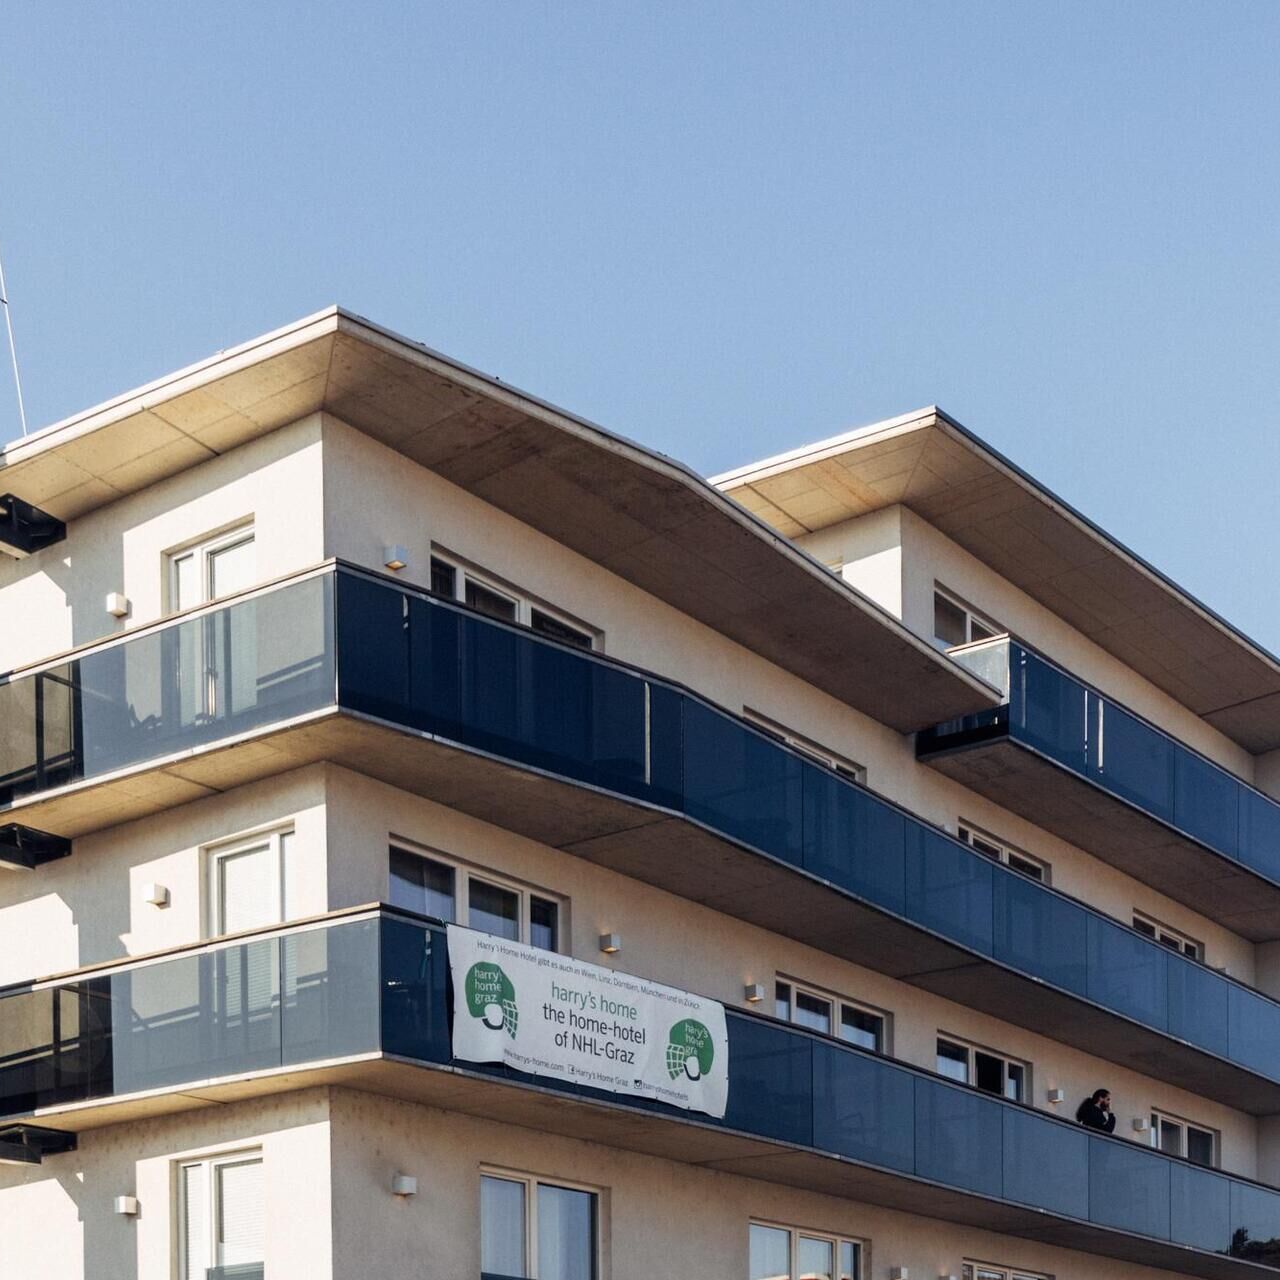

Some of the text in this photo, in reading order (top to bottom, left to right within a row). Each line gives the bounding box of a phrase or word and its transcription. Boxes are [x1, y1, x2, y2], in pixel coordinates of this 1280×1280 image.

[500, 946, 519, 958] Home
[520, 951, 536, 963] Hotel
[538, 957, 550, 967] gibt
[551, 961, 558, 969] es
[559, 964, 573, 974] auch
[474, 979, 502, 992] home
[474, 993, 497, 1004] graz
[551, 981, 638, 1020] harry's home
[542, 1003, 646, 1044] the home-hotel
[554, 1031, 635, 1065] of NHL-Graz
[685, 1046, 698, 1056] gra
[597, 1072, 614, 1083] Home
